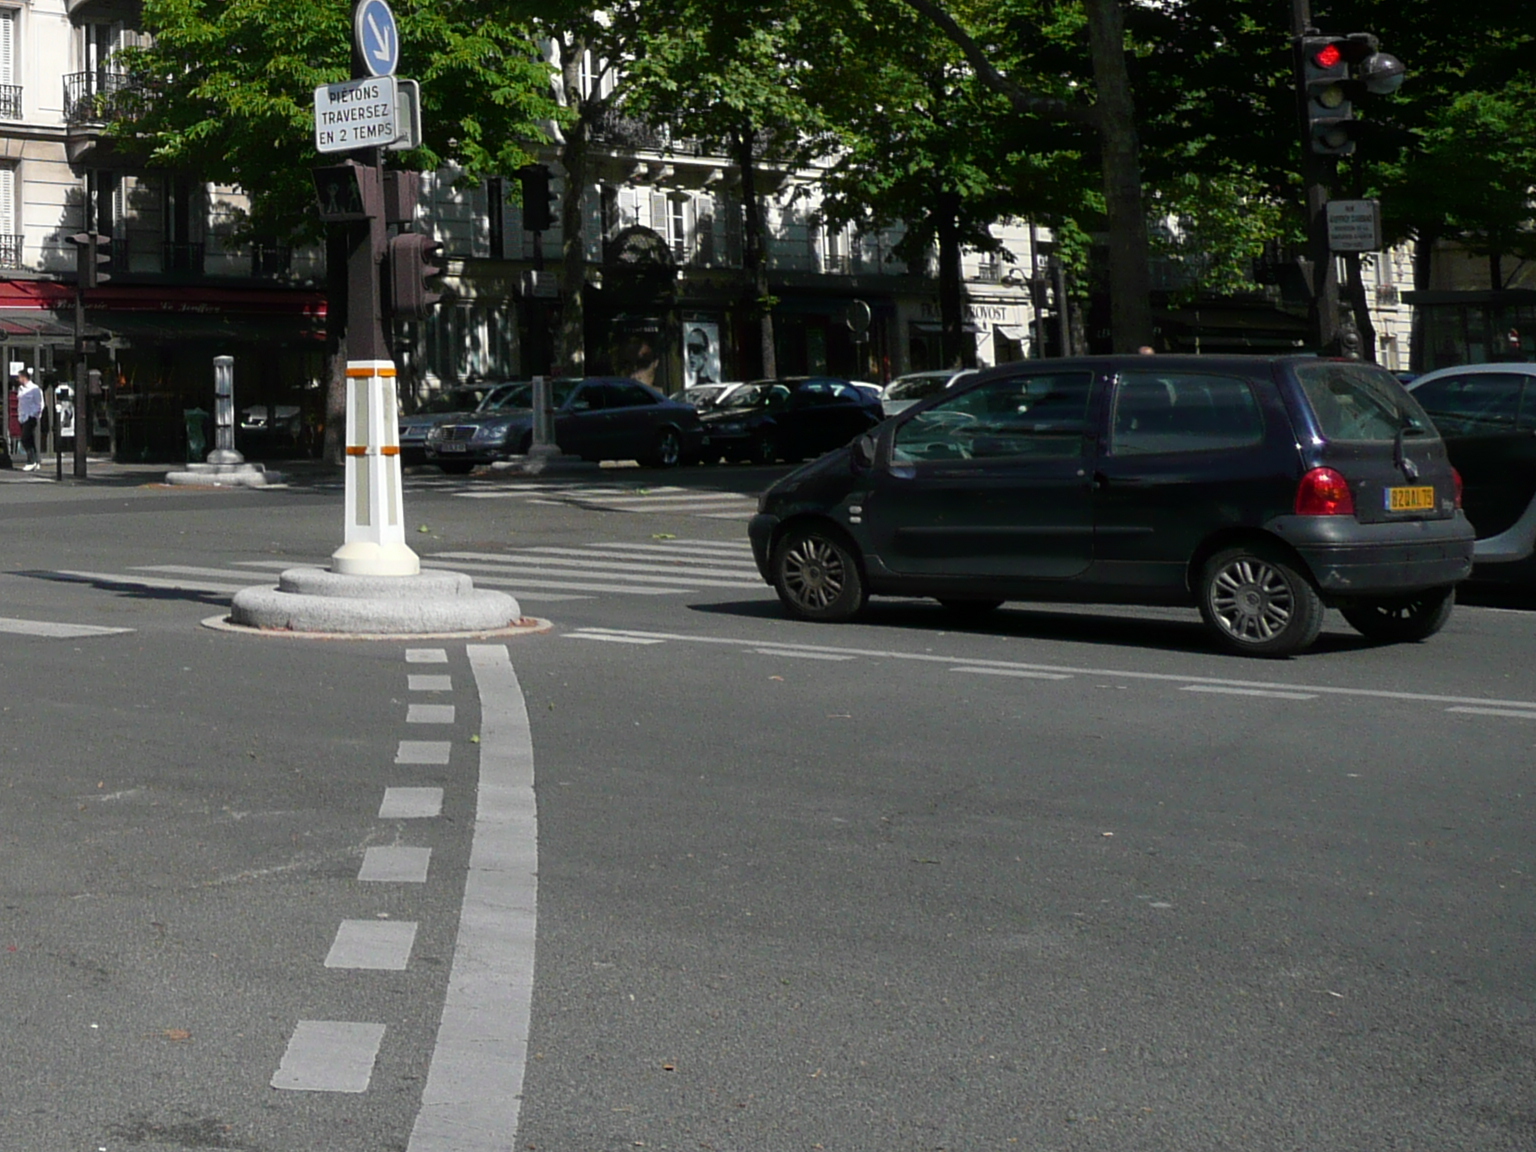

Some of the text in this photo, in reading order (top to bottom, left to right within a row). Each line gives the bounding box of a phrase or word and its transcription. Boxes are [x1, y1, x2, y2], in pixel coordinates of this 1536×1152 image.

[321, 103, 389, 125] TRAVERSEZ
[319, 122, 393, 145] EN 2 TEMPS
